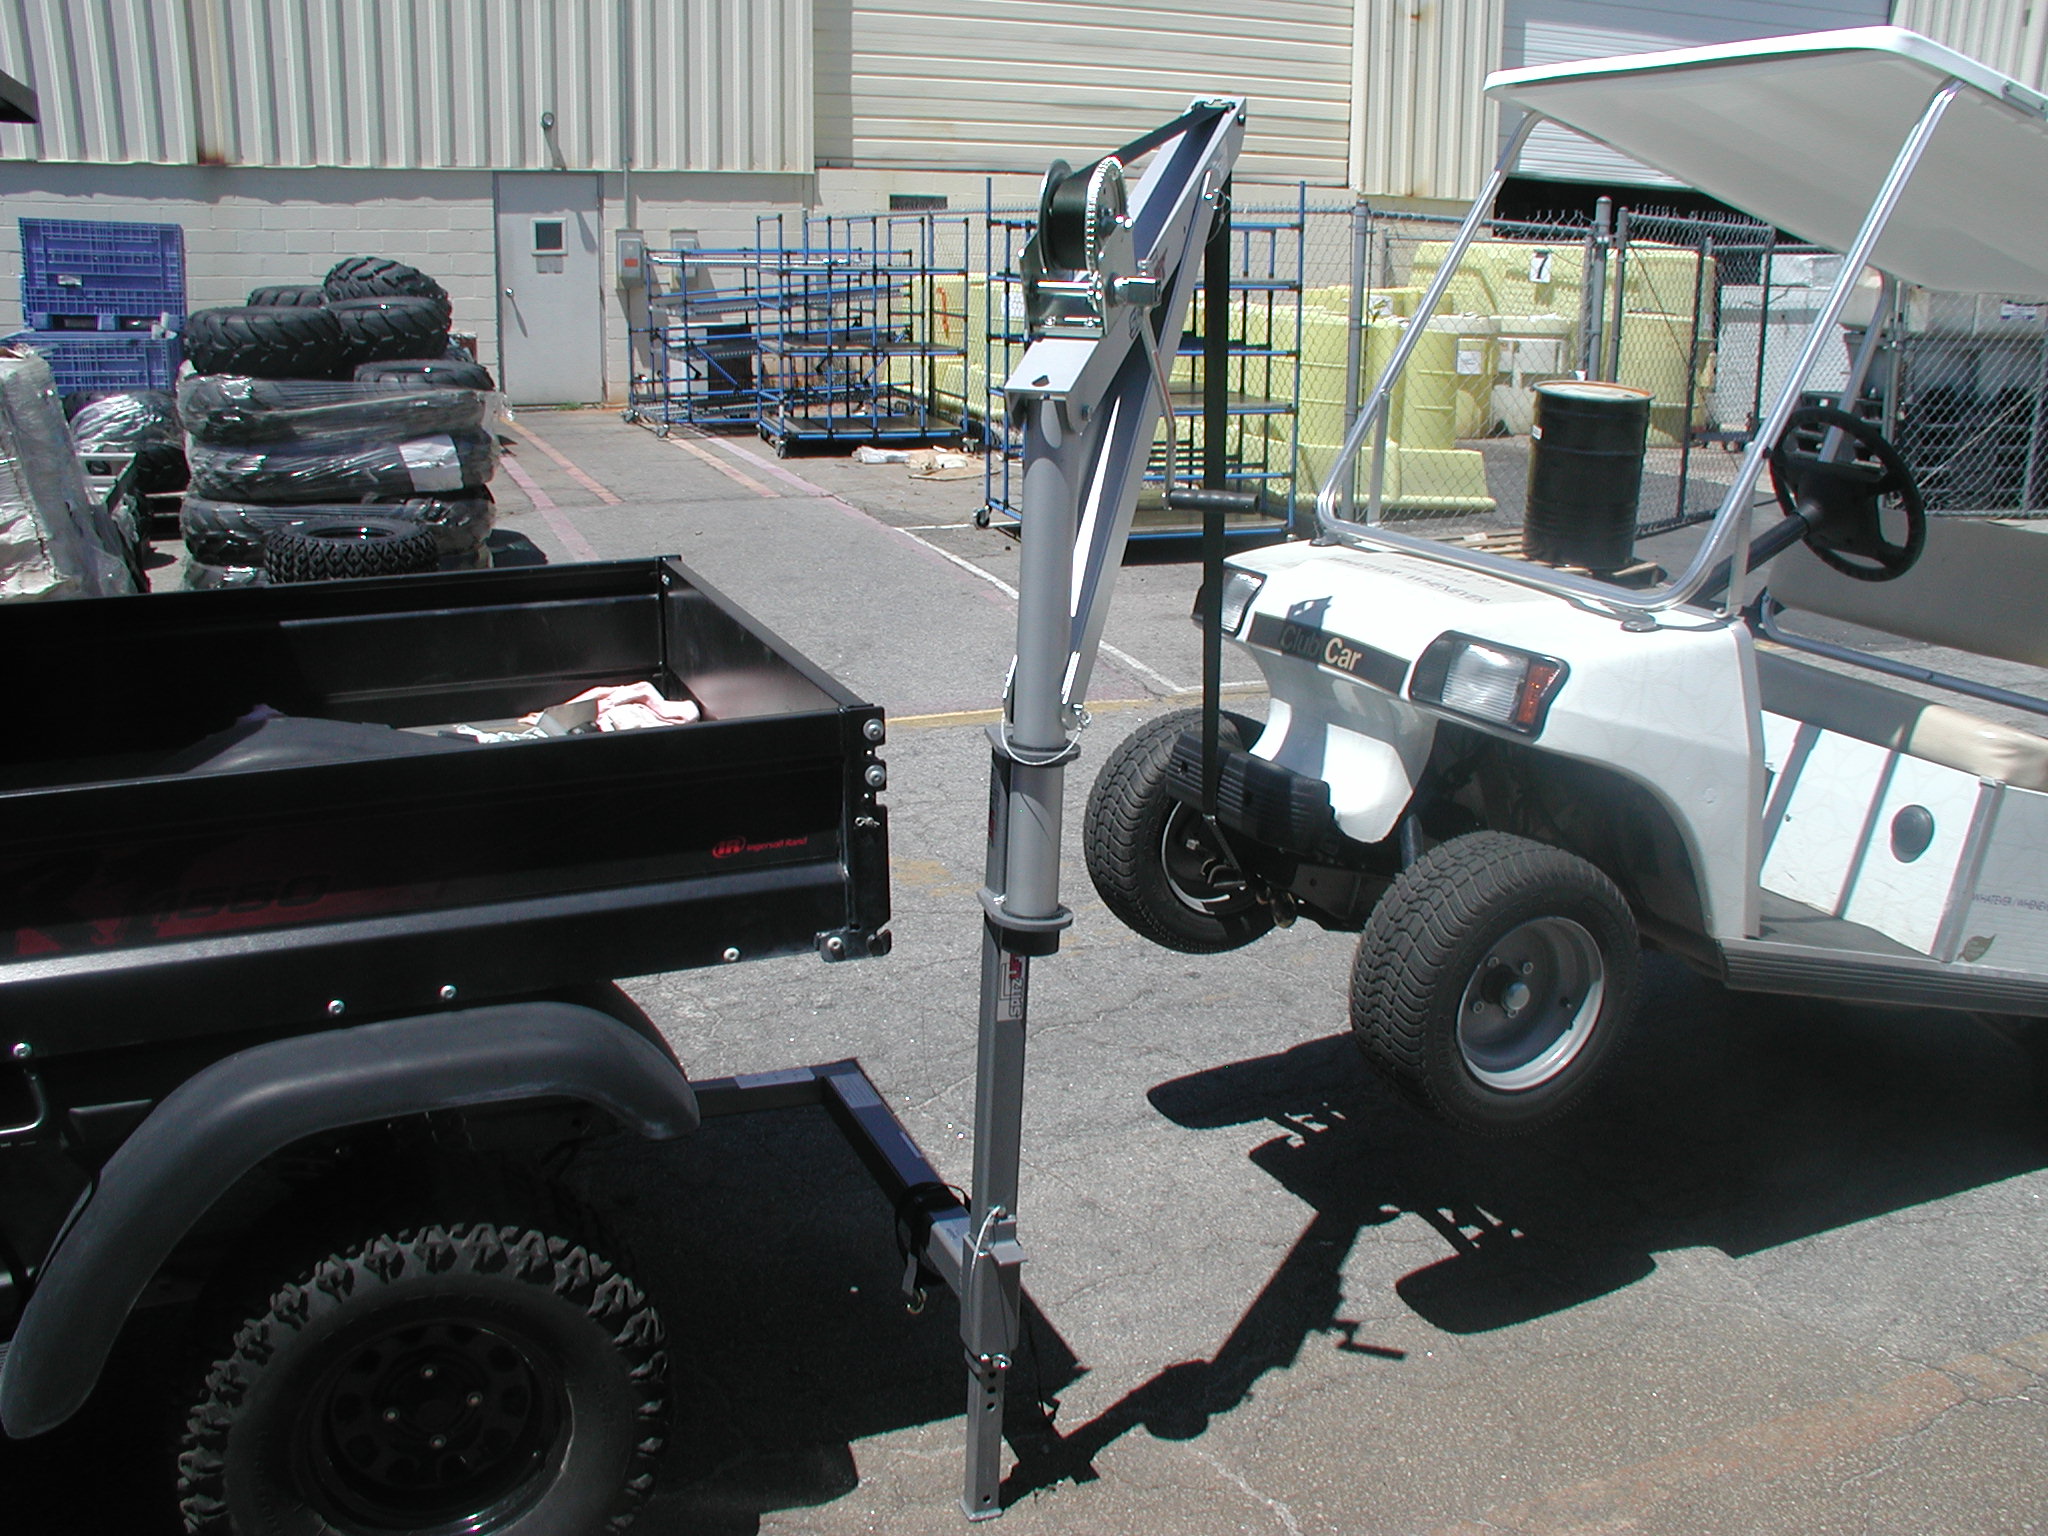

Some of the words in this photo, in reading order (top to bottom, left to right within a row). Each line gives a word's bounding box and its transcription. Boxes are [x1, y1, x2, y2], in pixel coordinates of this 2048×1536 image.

[1534, 249, 1551, 280] 7
[1280, 624, 1324, 657] Club
[1324, 636, 1363, 671] Car
